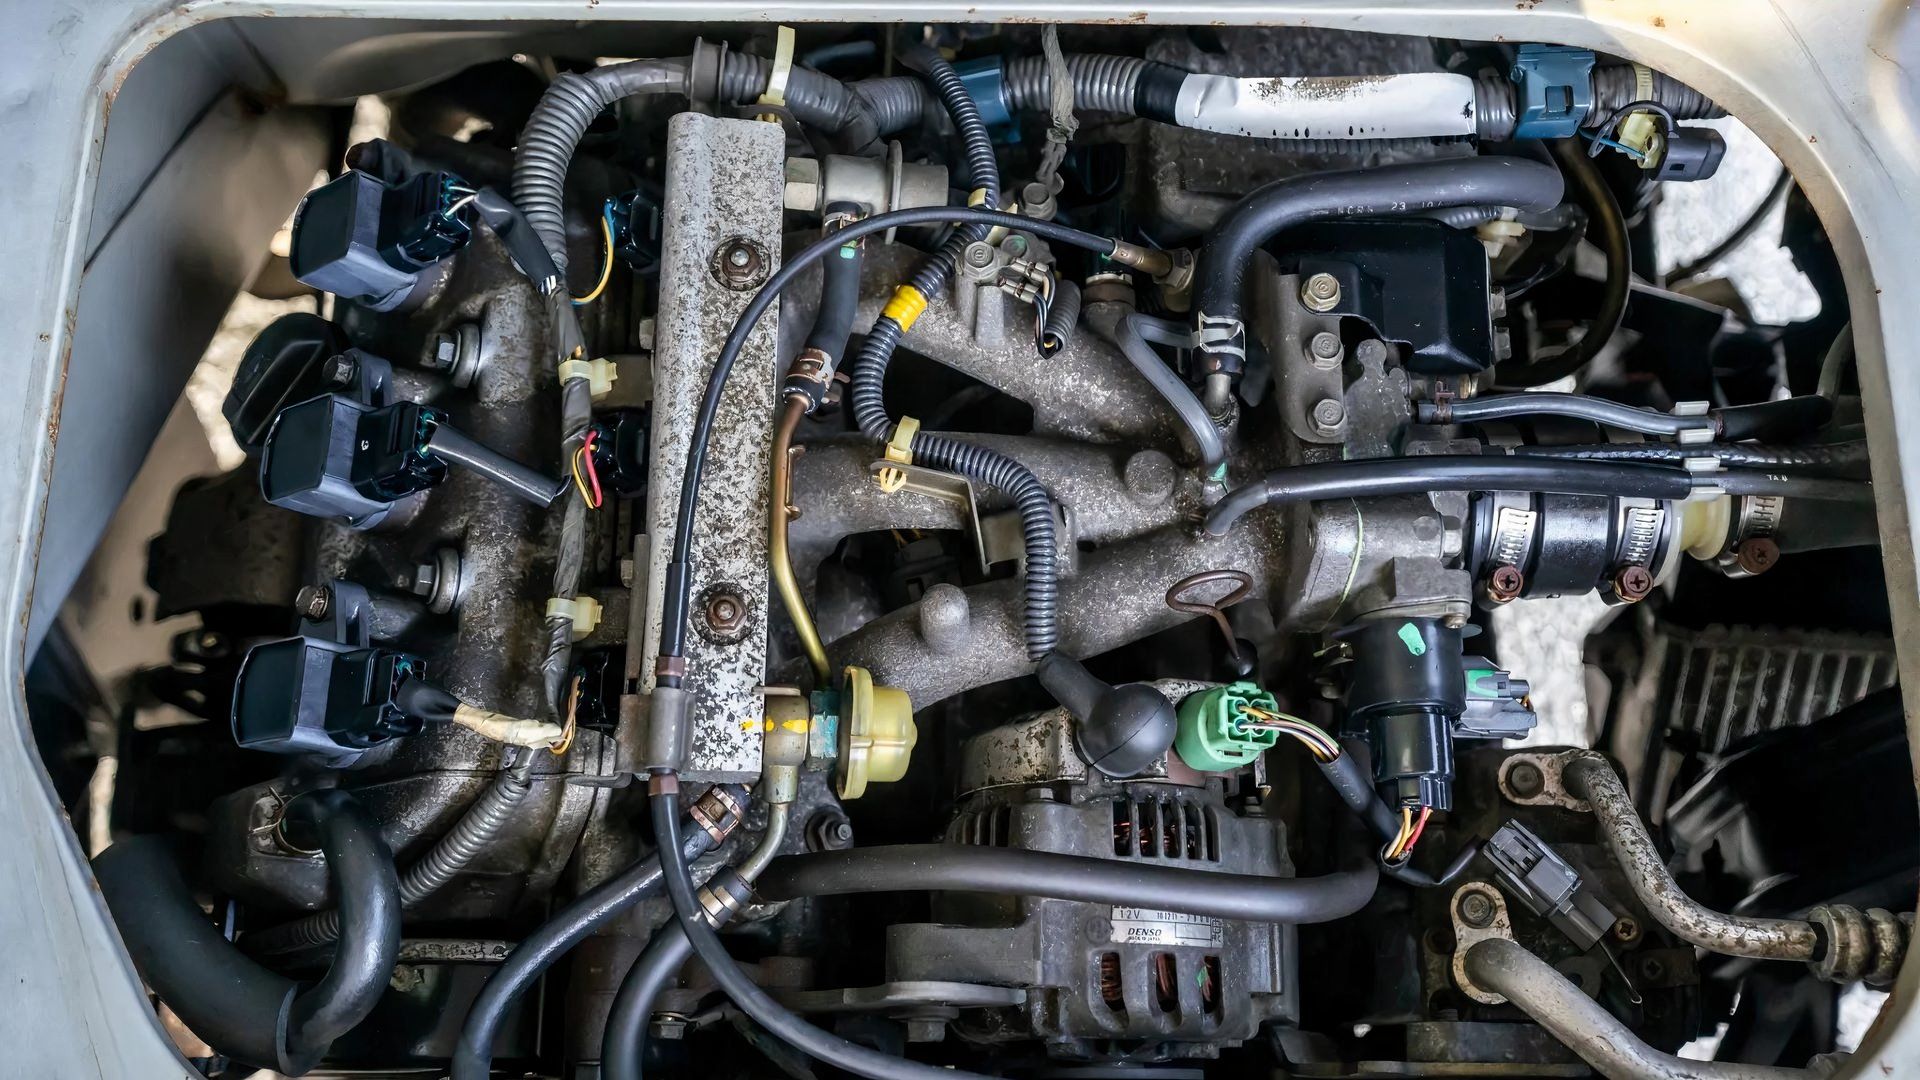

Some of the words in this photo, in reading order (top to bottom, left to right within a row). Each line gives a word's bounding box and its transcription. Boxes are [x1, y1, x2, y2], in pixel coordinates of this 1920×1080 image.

[1391, 201, 1406, 211] 23
[1120, 909, 1141, 920] 12V
[1127, 927, 1162, 937] DENSO
